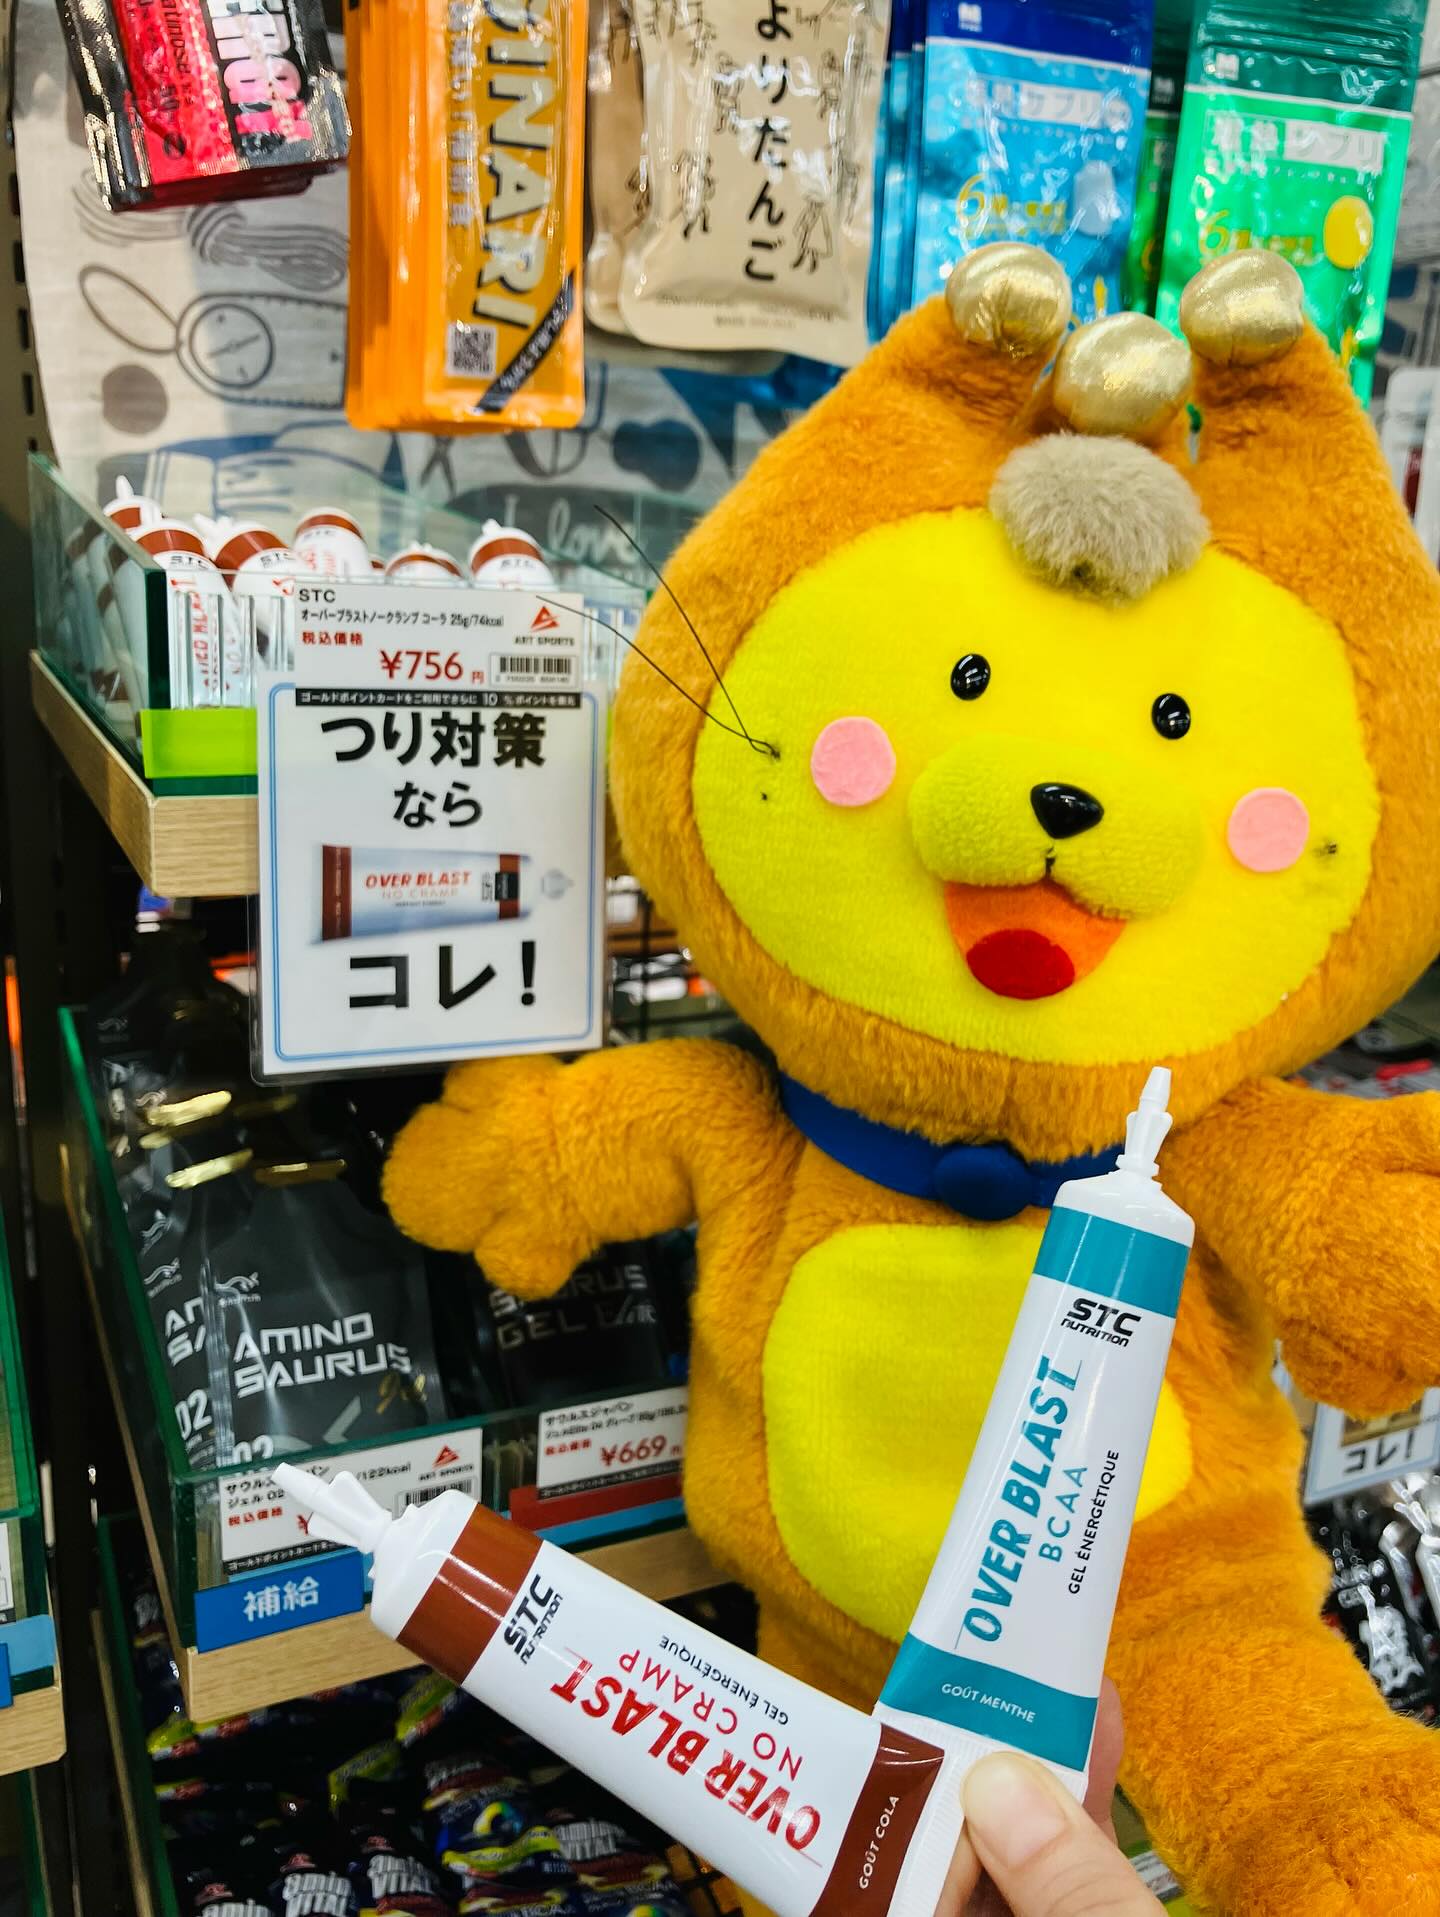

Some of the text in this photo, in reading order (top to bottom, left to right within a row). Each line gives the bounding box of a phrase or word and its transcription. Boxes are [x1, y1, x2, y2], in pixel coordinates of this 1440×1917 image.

[299, 588, 336, 603] STC
[302, 631, 363, 646] 税込価格
[380, 650, 464, 681] ¥756
[483, 692, 498, 706] 10
[321, 710, 546, 768] つり対策
[393, 781, 483, 828] なら
[365, 873, 411, 889] OVER
[415, 871, 472, 887] BLAST
[349, 941, 536, 1010] コレ!
[233, 1312, 374, 1363] AMINO
[1066, 1297, 1142, 1337] STC
[233, 1342, 412, 1399] SAURUS
[601, 1434, 667, 1468] ¥669
[962, 1355, 1079, 1643] OVER BLAST
[1038, 1465, 1088, 1563] BCAA
[1068, 1450, 1120, 1594] GEL ÉNERGÉTIQUE
[243, 1576, 320, 1623] 補給
[503, 1574, 554, 1656] STC
[658, 1634, 789, 1726] GEL ÉNERGÉTIQUE
[941, 1682, 1036, 1723] GOÛT MENTHE
[618, 1648, 803, 1782] NO CRAMP
[550, 1657, 821, 1852] OVER BLAST
[858, 1795, 900, 1889] GOÛT COLA
